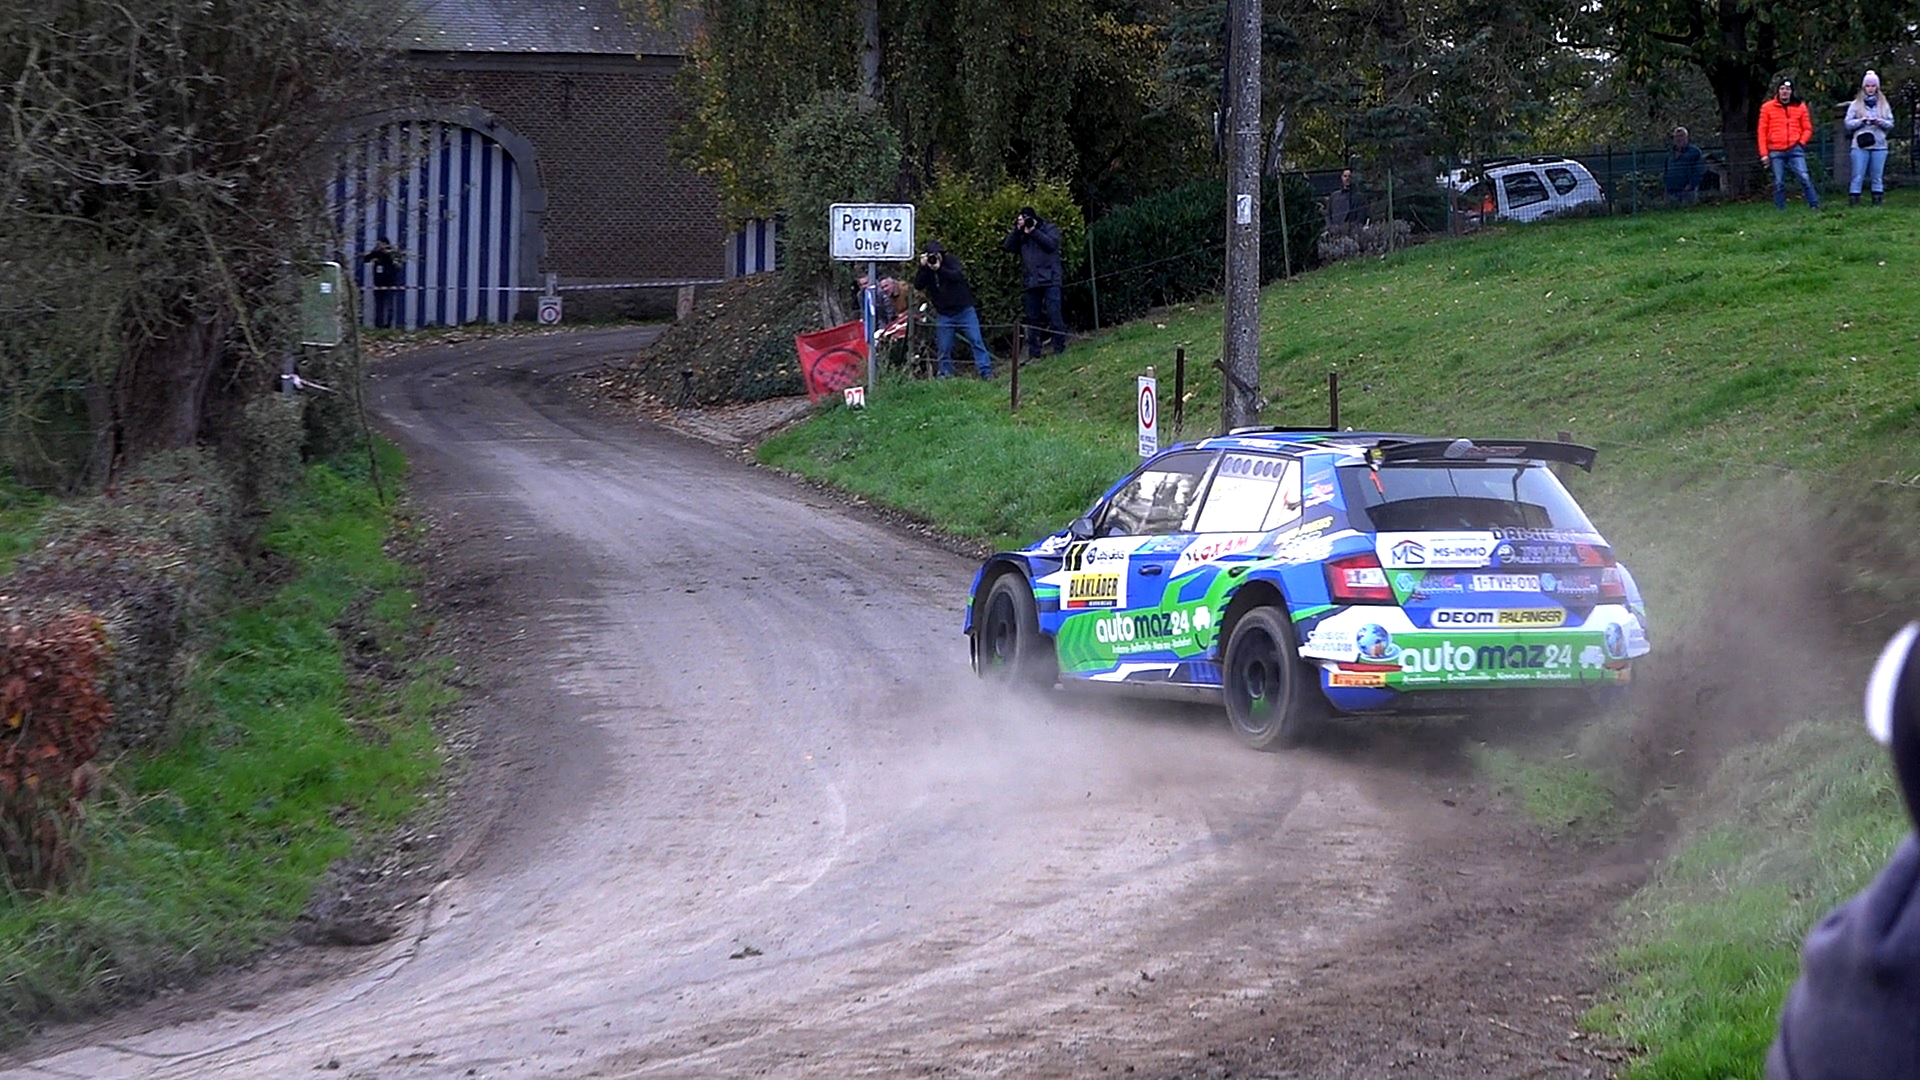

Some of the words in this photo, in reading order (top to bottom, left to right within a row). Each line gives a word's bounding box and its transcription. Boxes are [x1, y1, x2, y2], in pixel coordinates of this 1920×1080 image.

[842, 214, 902, 232] Perwez
[855, 238, 889, 253] Ohey
[1392, 546, 1426, 564] MS
[1433, 547, 1487, 557] MS-IMMO
[1069, 573, 1118, 598] BLÅKLÄDER
[1476, 576, 1539, 590] 1-TVH-010
[1437, 611, 1494, 623] DEOM
[1498, 610, 1562, 624] PALFINGER
[1096, 610, 1190, 643] automaz24
[1398, 641, 1572, 672] automaz24
